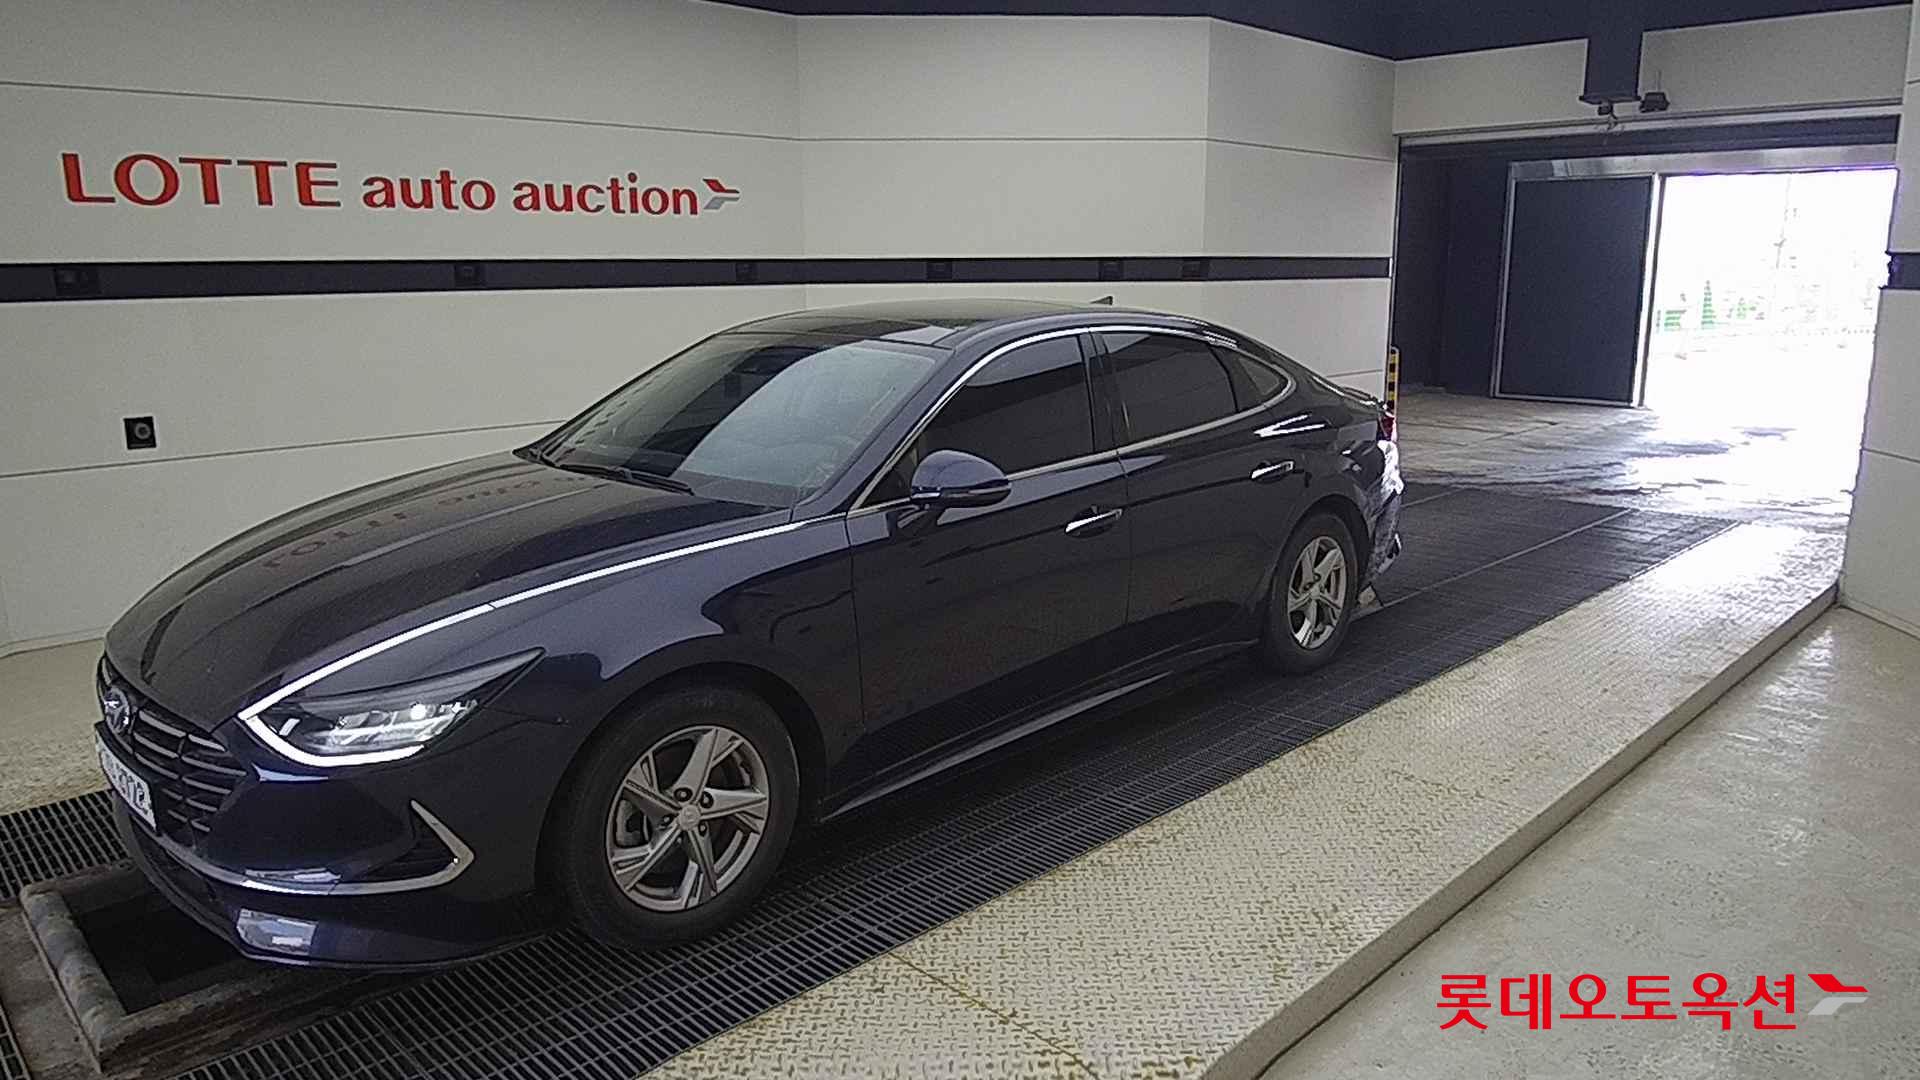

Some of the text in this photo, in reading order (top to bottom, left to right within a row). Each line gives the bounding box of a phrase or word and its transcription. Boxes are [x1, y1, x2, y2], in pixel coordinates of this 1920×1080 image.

[62, 152, 699, 215] LOTTE auto auction
